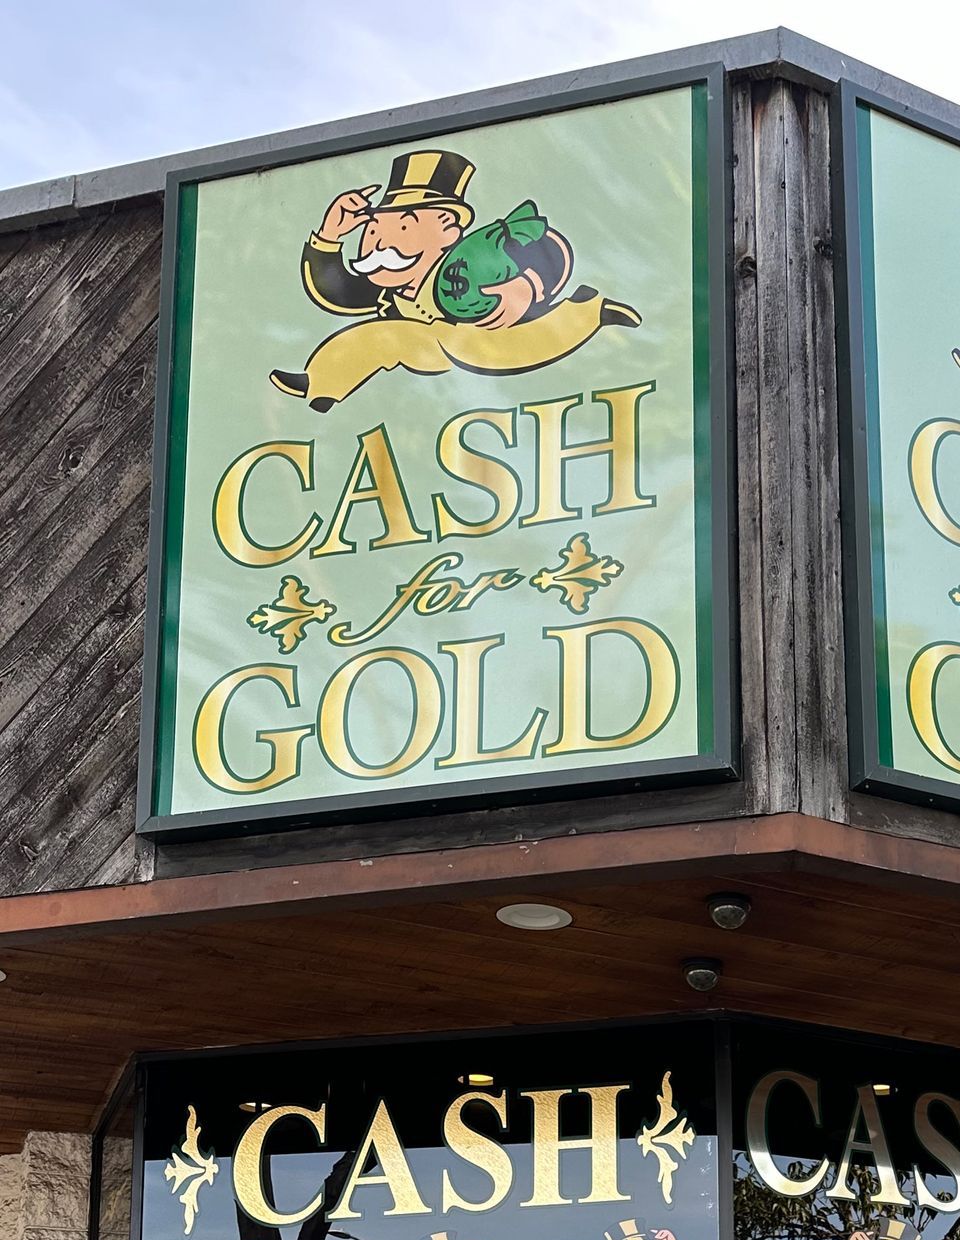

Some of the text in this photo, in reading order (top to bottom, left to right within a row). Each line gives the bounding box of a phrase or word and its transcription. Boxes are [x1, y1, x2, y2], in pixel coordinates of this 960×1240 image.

[212, 380, 657, 568] CASH
[327, 552, 525, 645] for
[192, 616, 681, 795] GOLD
[232, 1085, 632, 1227] CASH
